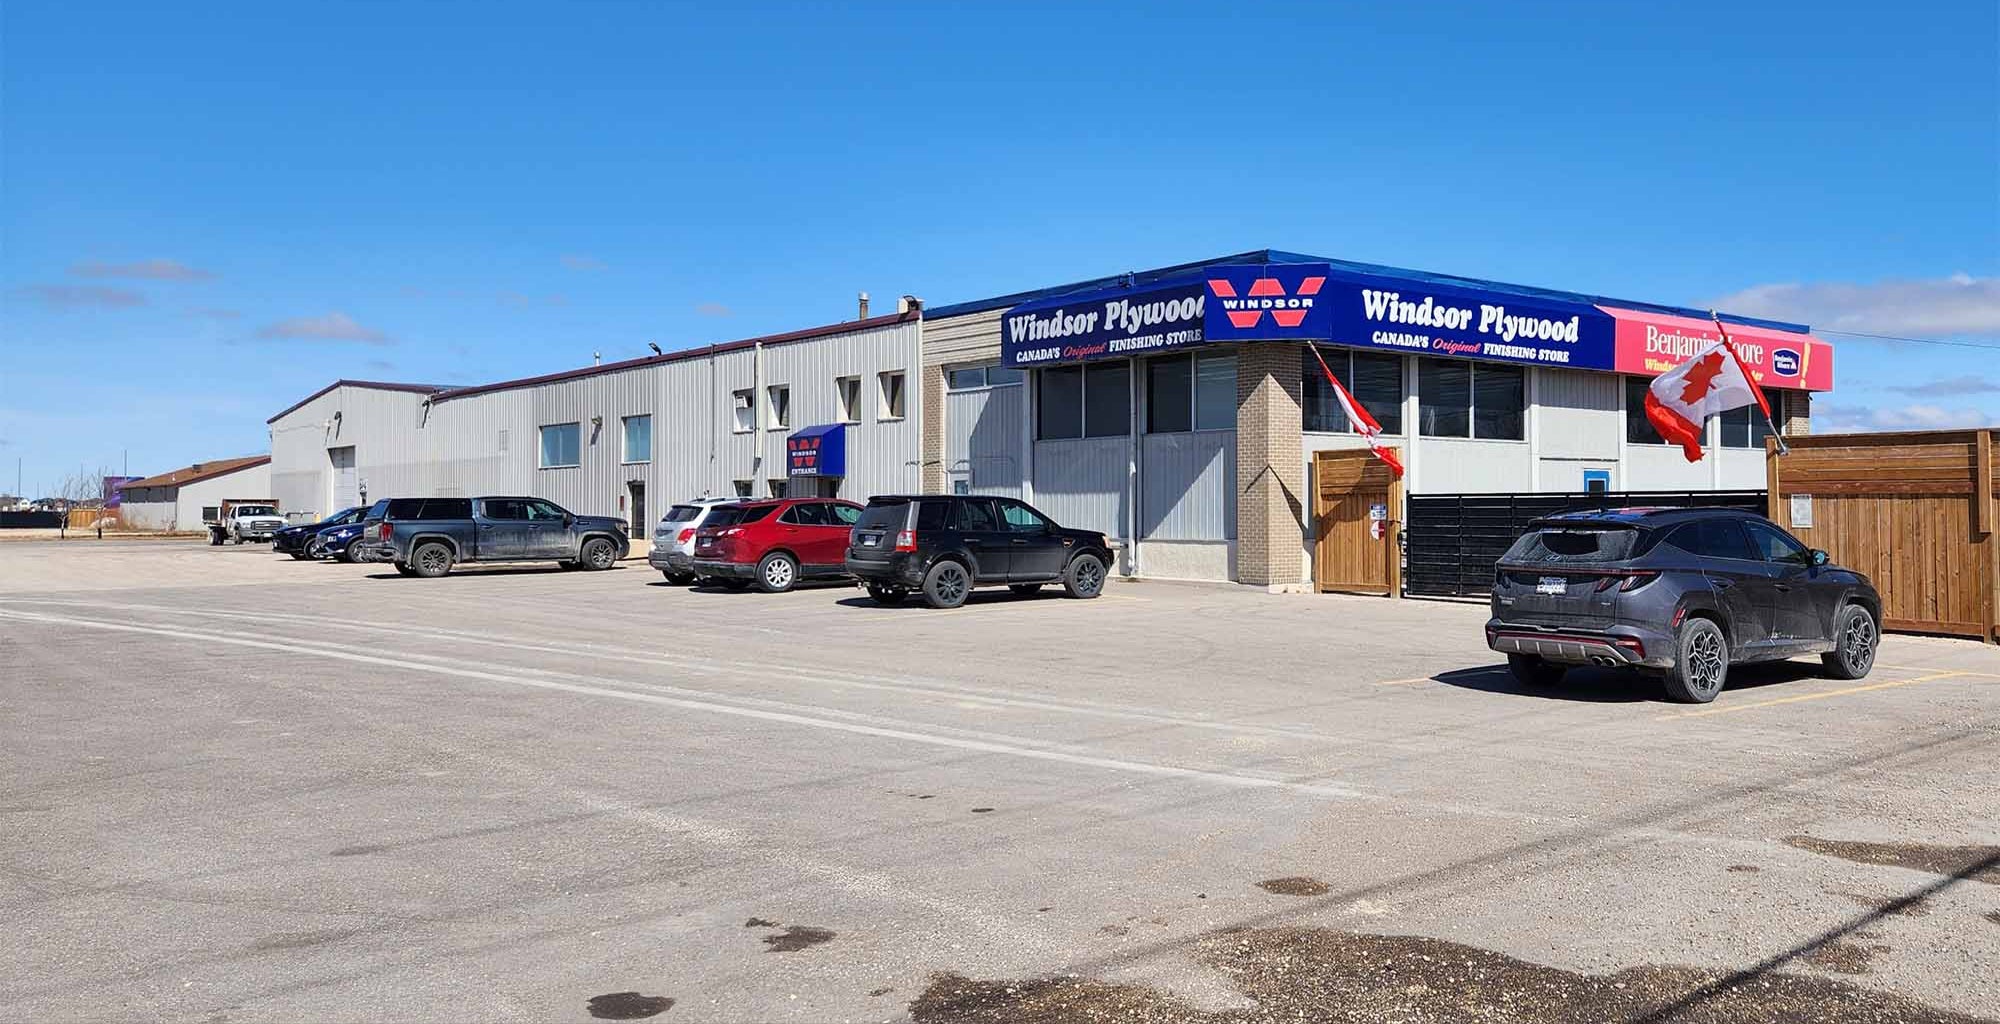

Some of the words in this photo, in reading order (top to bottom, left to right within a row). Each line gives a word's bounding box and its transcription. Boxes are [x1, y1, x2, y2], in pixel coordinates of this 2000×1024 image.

[1224, 298, 1313, 309] WINDSOR
[1361, 289, 1472, 330] Windsor
[1478, 304, 1579, 343] Plywood
[1009, 307, 1098, 344] Windsor
[1016, 346, 1061, 363] CANADA'S
[1064, 343, 1106, 359] Original
[1108, 334, 1165, 353] FINISHING
[1166, 329, 1202, 346] STORE
[1373, 331, 1429, 348] CANADA'S
[1432, 337, 1481, 355] Original
[1483, 342, 1537, 361] FINISHING
[1537, 348, 1570, 363] STORE
